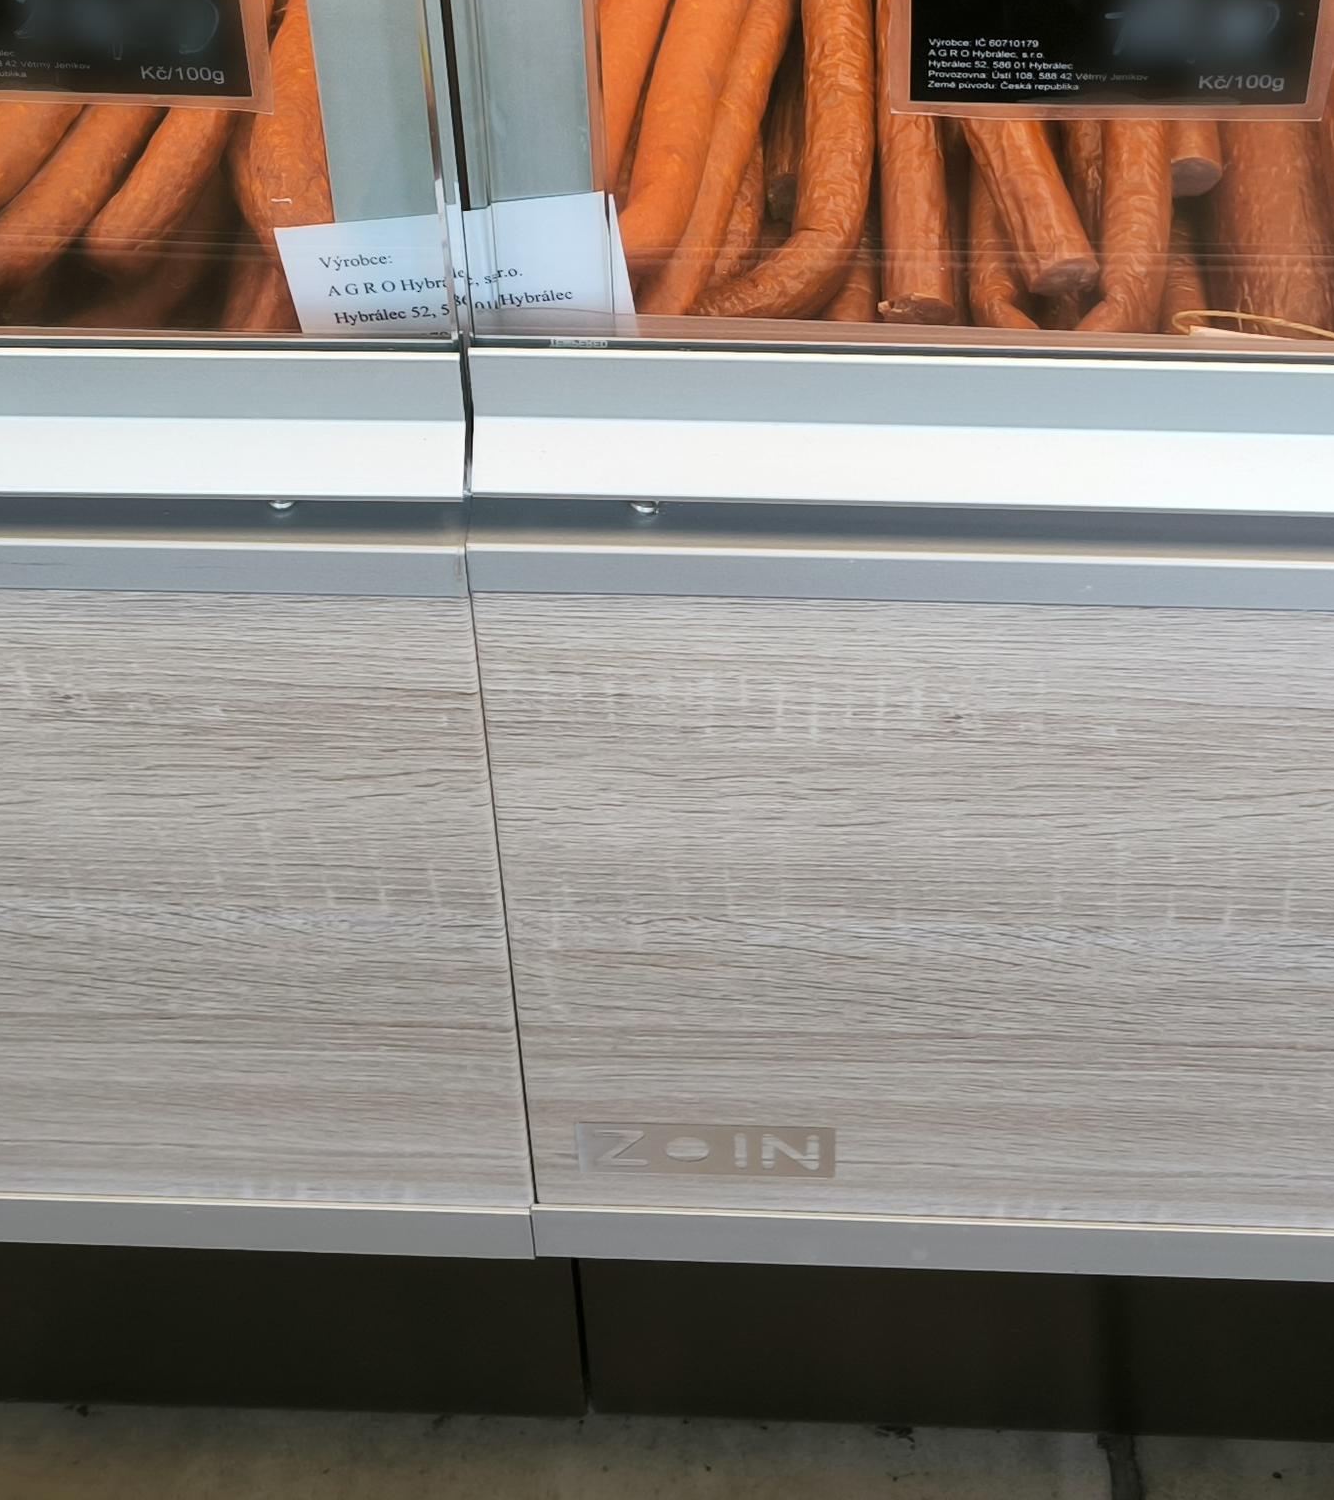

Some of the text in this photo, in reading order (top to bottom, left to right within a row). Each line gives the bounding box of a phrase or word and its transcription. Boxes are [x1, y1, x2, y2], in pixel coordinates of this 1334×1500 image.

[975, 38, 986, 47] IČ
[989, 39, 1039, 48] 60710179
[140, 64, 226, 84] Kč/100g
[1060, 72, 1072, 80] 42
[1197, 73, 1286, 92] Kč/100g
[927, 80, 956, 89] Země
[1000, 81, 1031, 90] Česká
[1035, 82, 1079, 91] republika
[319, 254, 393, 271] Výrobce:
[335, 290, 573, 326] Hybrálec 52, Hybrálec
